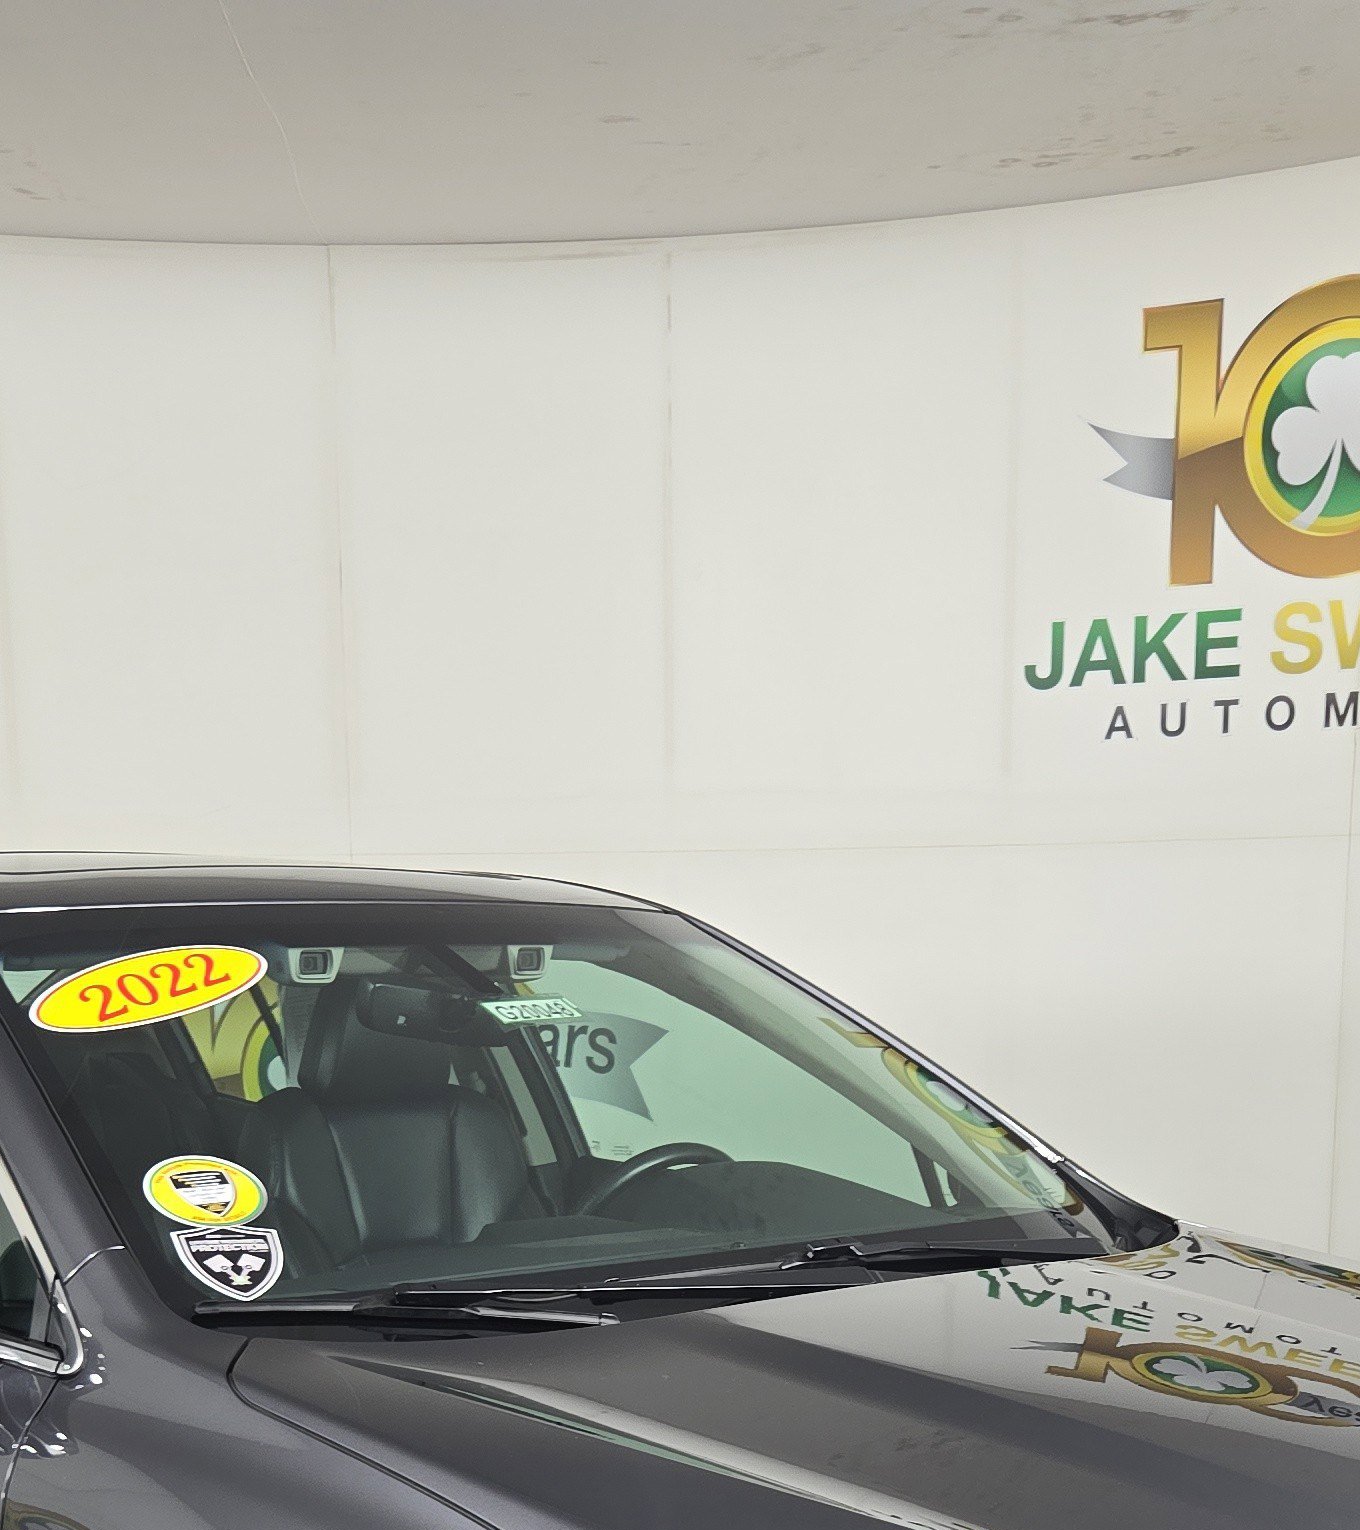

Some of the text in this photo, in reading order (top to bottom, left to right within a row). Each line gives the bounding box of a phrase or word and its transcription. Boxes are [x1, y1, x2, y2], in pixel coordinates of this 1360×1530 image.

[1024, 608, 1243, 690] JAKE
[78, 953, 232, 1023] 2022
[495, 1002, 575, 1020] G20048
[538, 1023, 617, 1075] ars
